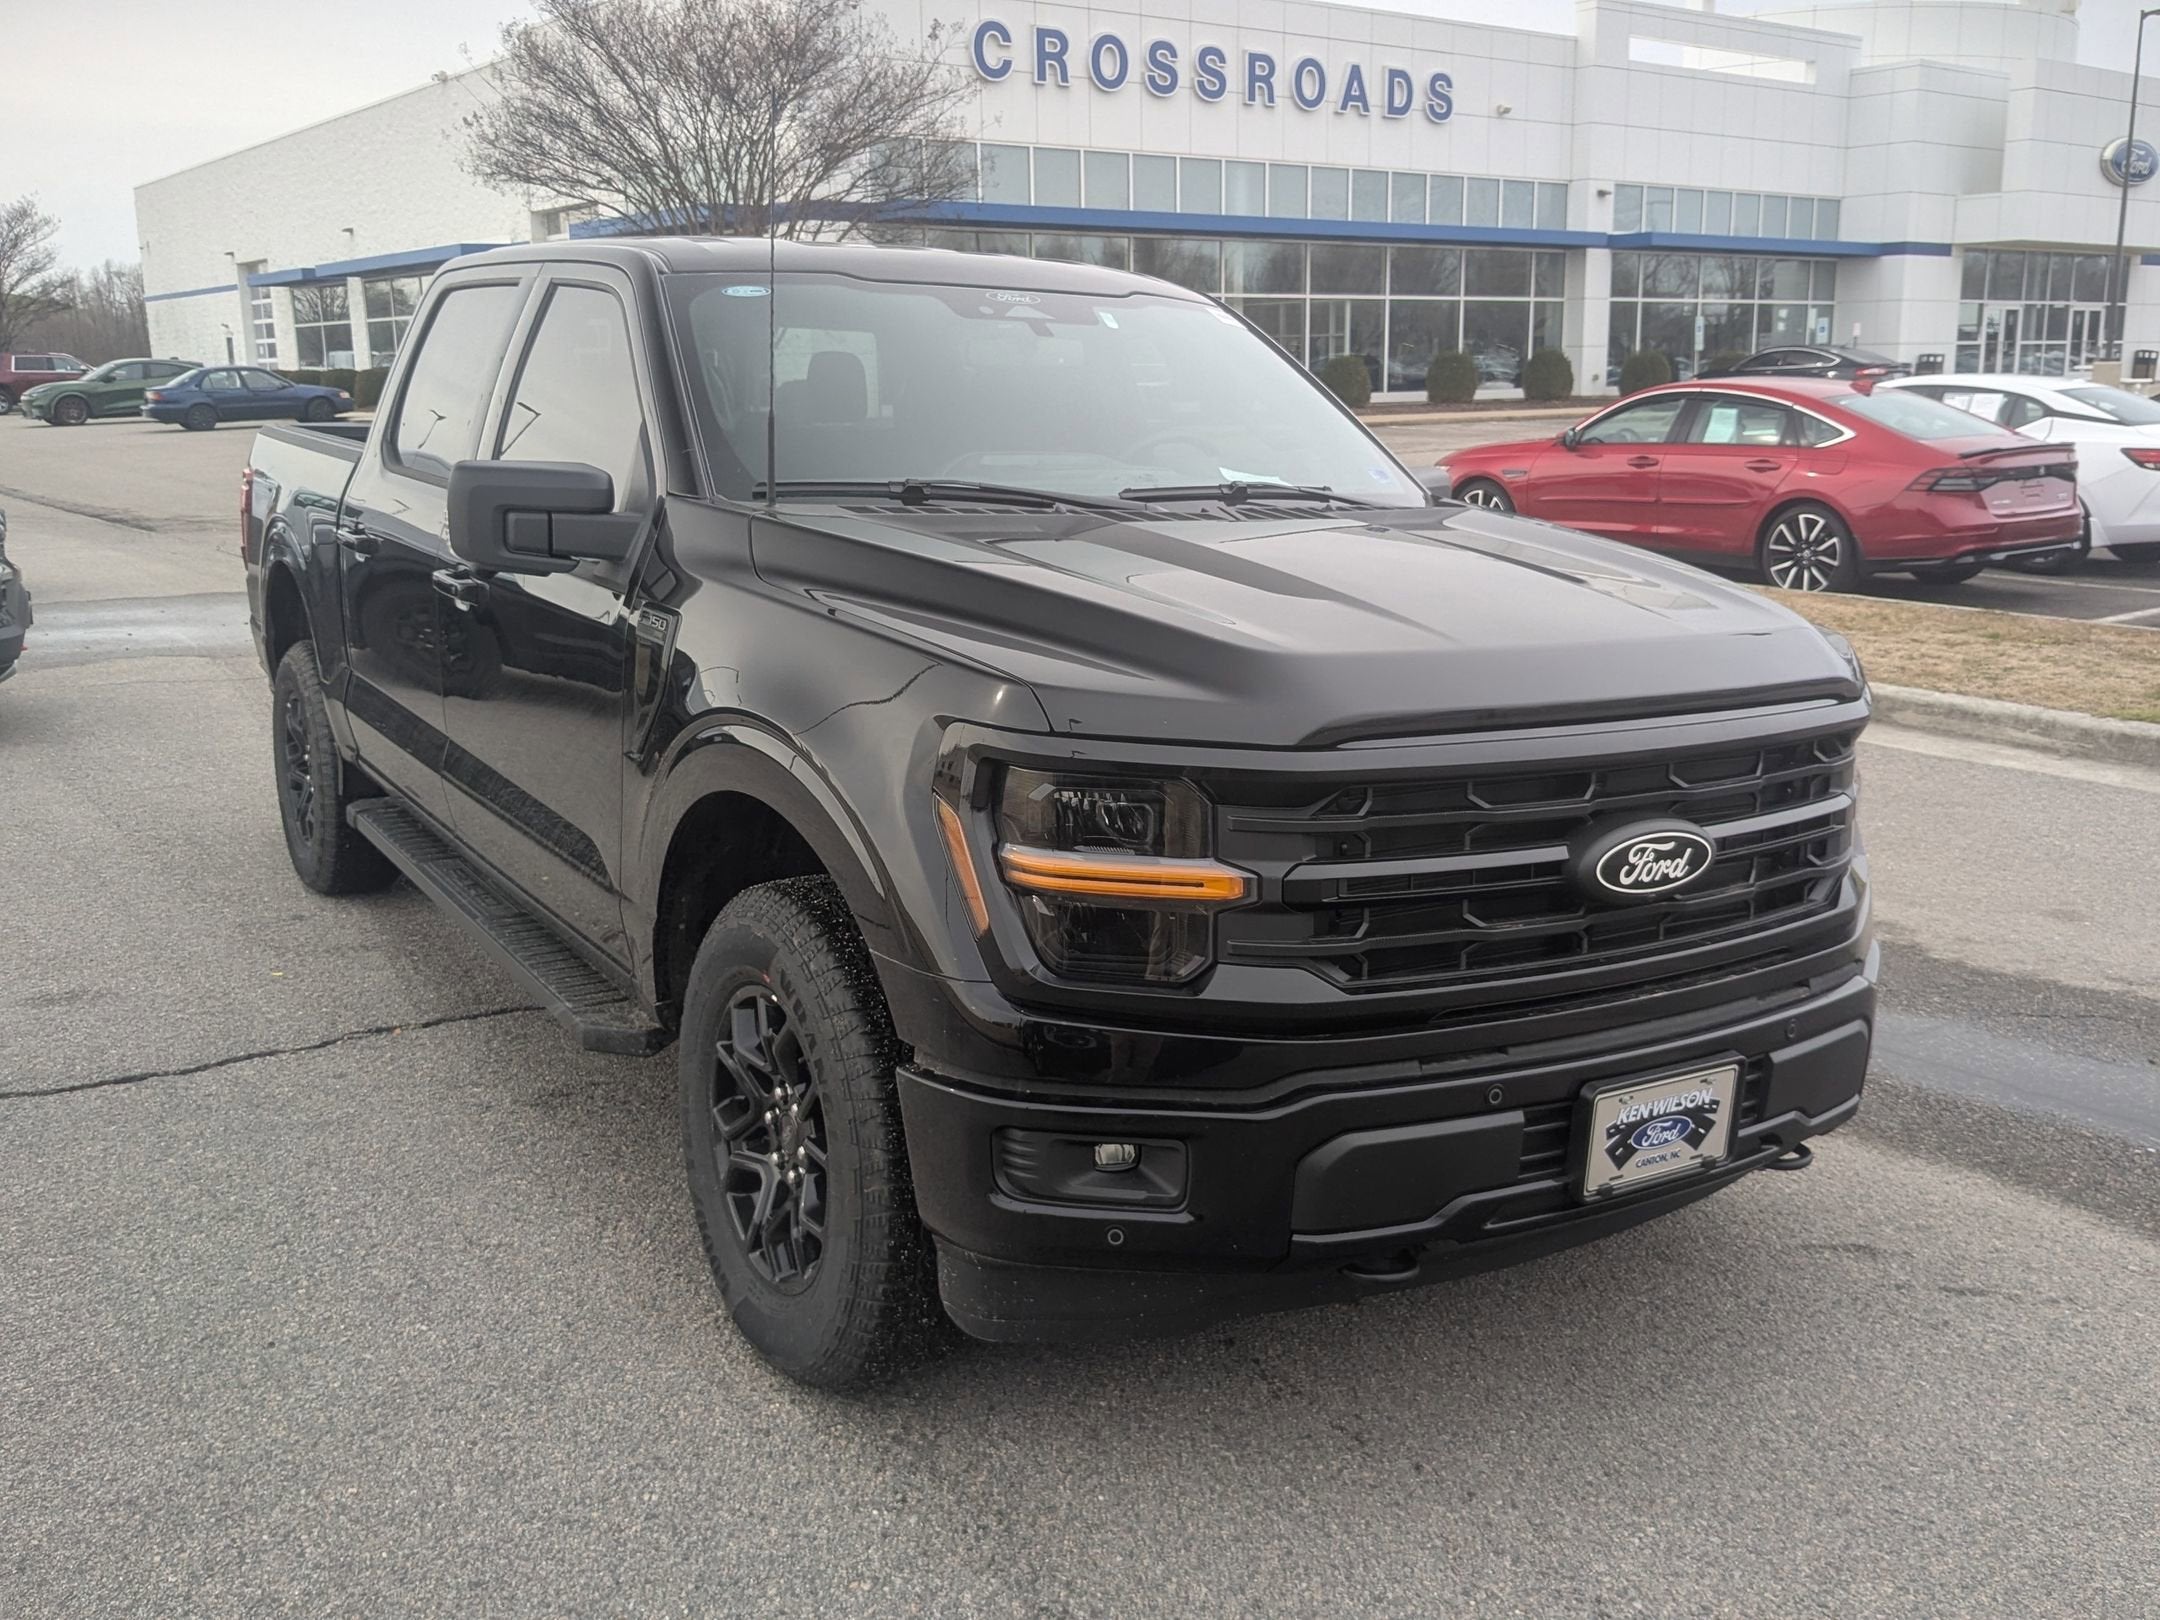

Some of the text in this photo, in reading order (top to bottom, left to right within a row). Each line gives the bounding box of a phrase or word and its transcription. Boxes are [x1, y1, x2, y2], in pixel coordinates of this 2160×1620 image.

[972, 19, 1455, 123] CROSSROADS
[2120, 147, 2153, 175] Ford
[996, 290, 1031, 303] Ford
[1619, 841, 1692, 885] Ford
[1617, 1088, 1713, 1124] KEN WILSON
[1642, 1120, 1682, 1146] Ford
[1636, 1147, 1681, 1168] CANTON, NC
